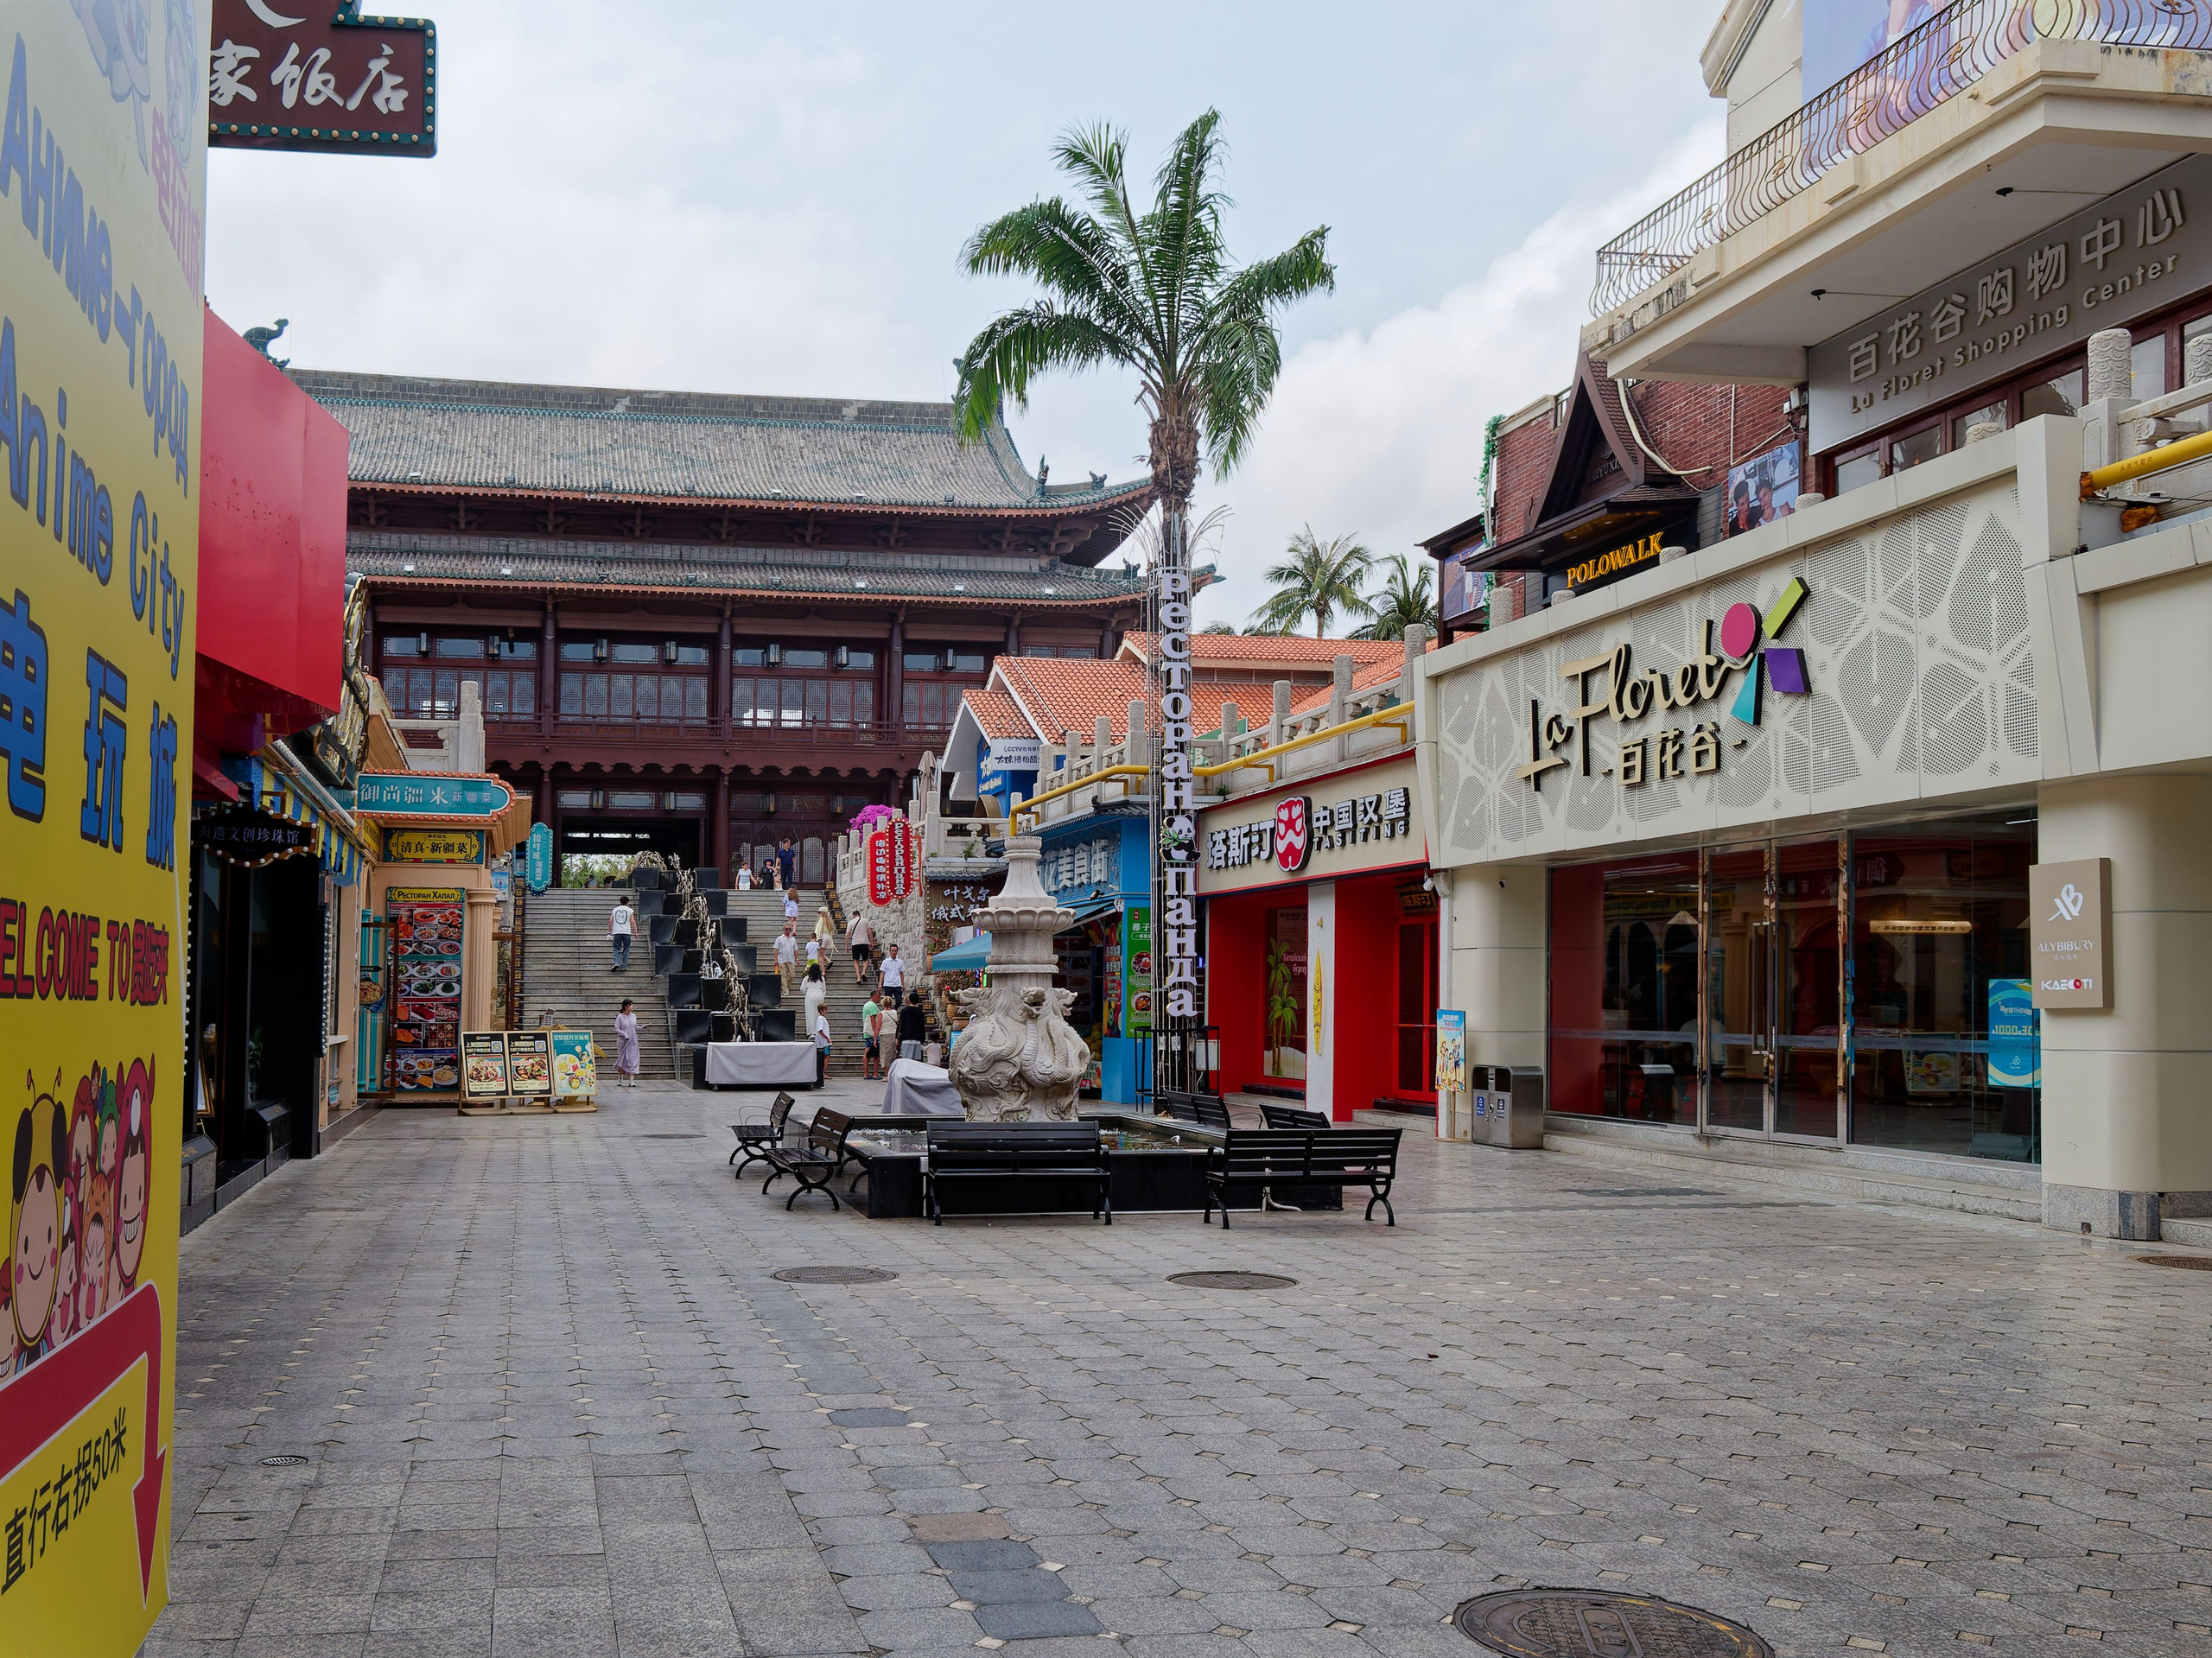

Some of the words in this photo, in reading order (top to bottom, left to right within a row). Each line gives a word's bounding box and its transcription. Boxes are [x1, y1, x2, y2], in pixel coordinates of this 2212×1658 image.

[1848, 187, 2185, 384] 百花谷购物中心
[1851, 391, 1873, 414] La
[1881, 356, 1946, 402] Floret
[1955, 303, 2070, 369] Shopping
[2082, 254, 2179, 310] Center
[0, 316, 113, 586] Anime
[130, 490, 184, 681] City
[1567, 531, 1664, 588] POLOWALK
[1515, 699, 1573, 791] La
[1559, 619, 1756, 777] Floret
[995, 754, 1039, 765] 太琼糟粕醋
[1617, 721, 1722, 787] 百花谷
[451, 791, 493, 804] 新疆菜
[1313, 787, 1409, 834] 中国汉堡
[401, 842, 468, 854] 清真·新疆菜
[1206, 818, 1276, 869] 塔斯汀
[1313, 820, 1409, 851] TASITING
[944, 886, 990, 902] 叶戈尔
[107, 919, 130, 1001] TO
[2, 1407, 127, 1596] 直行右拐50米
